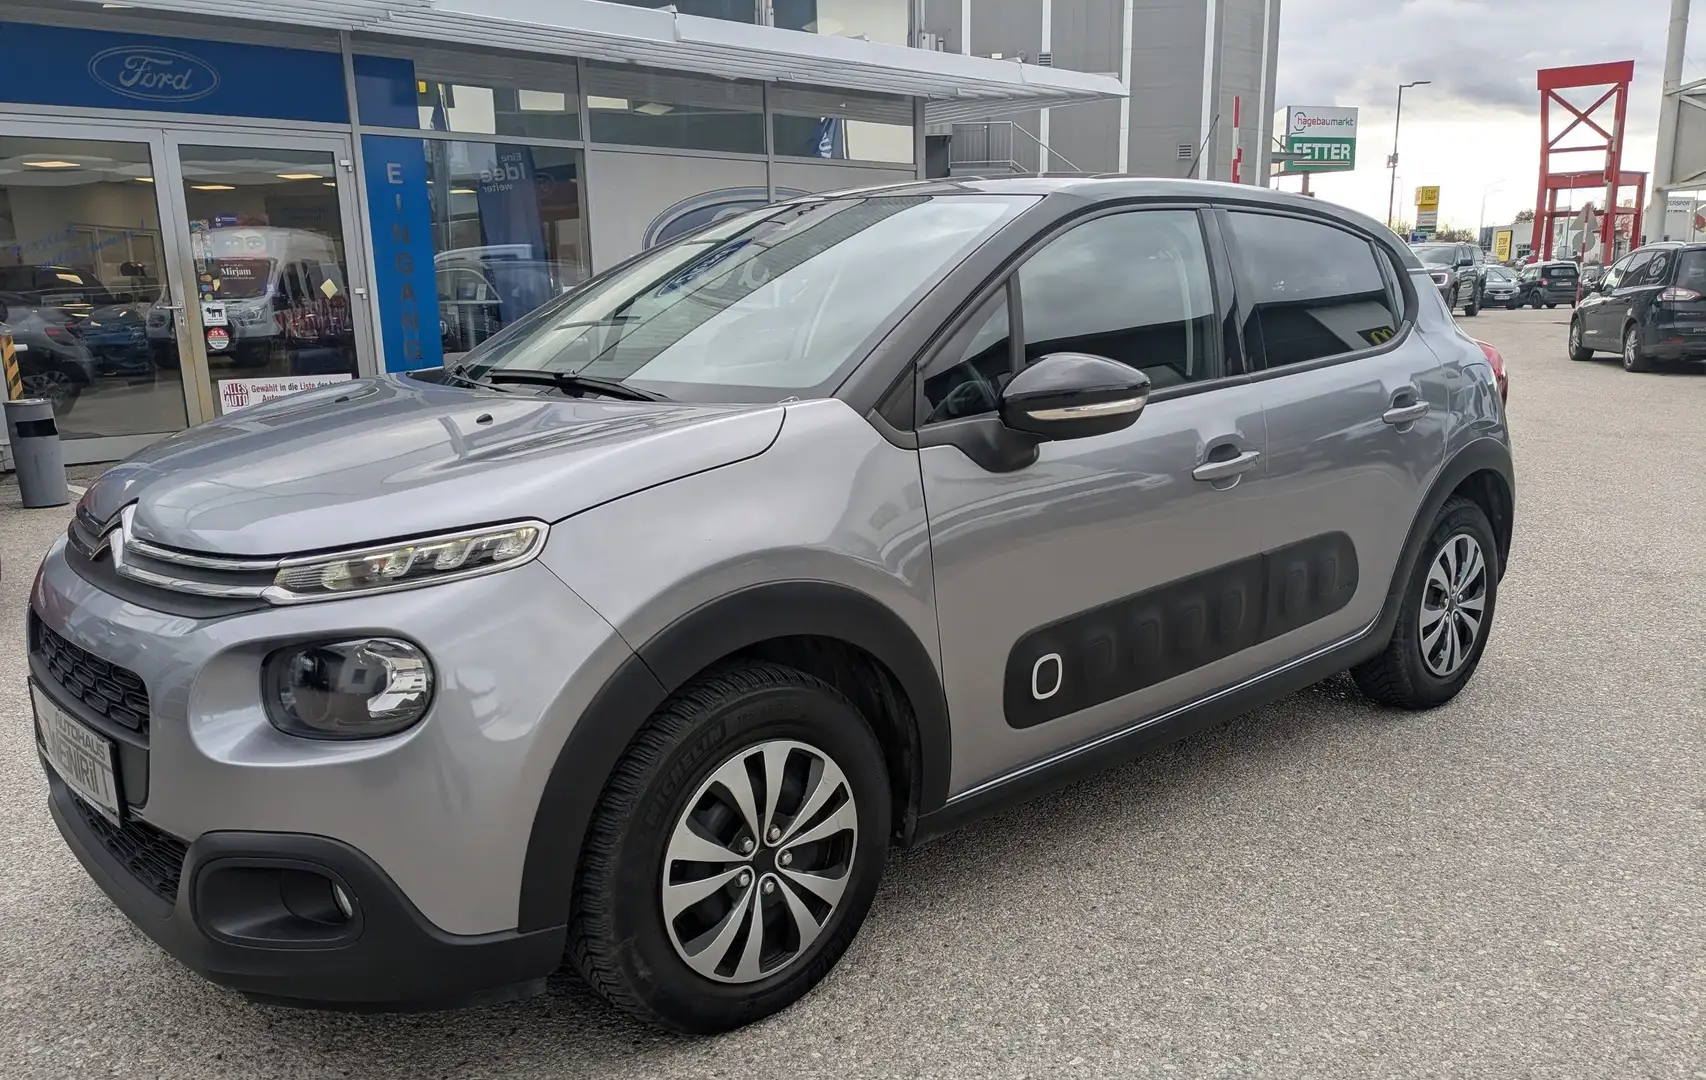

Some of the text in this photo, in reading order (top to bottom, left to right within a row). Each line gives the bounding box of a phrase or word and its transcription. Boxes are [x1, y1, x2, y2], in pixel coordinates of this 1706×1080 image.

[119, 55, 193, 90] Ford
[1297, 116, 1354, 127] hagebaumarkt
[386, 162, 423, 362] EINGANG
[220, 267, 252, 277] Mirjam
[223, 383, 249, 395] ALLES
[251, 384, 279, 393] Gewählt
[280, 383, 287, 391] in
[288, 382, 299, 391] die
[300, 381, 316, 391] Liste
[224, 394, 250, 407] AUTO
[55, 710, 106, 761] AUTOHAUS
[641, 718, 727, 831] MICHELIN
